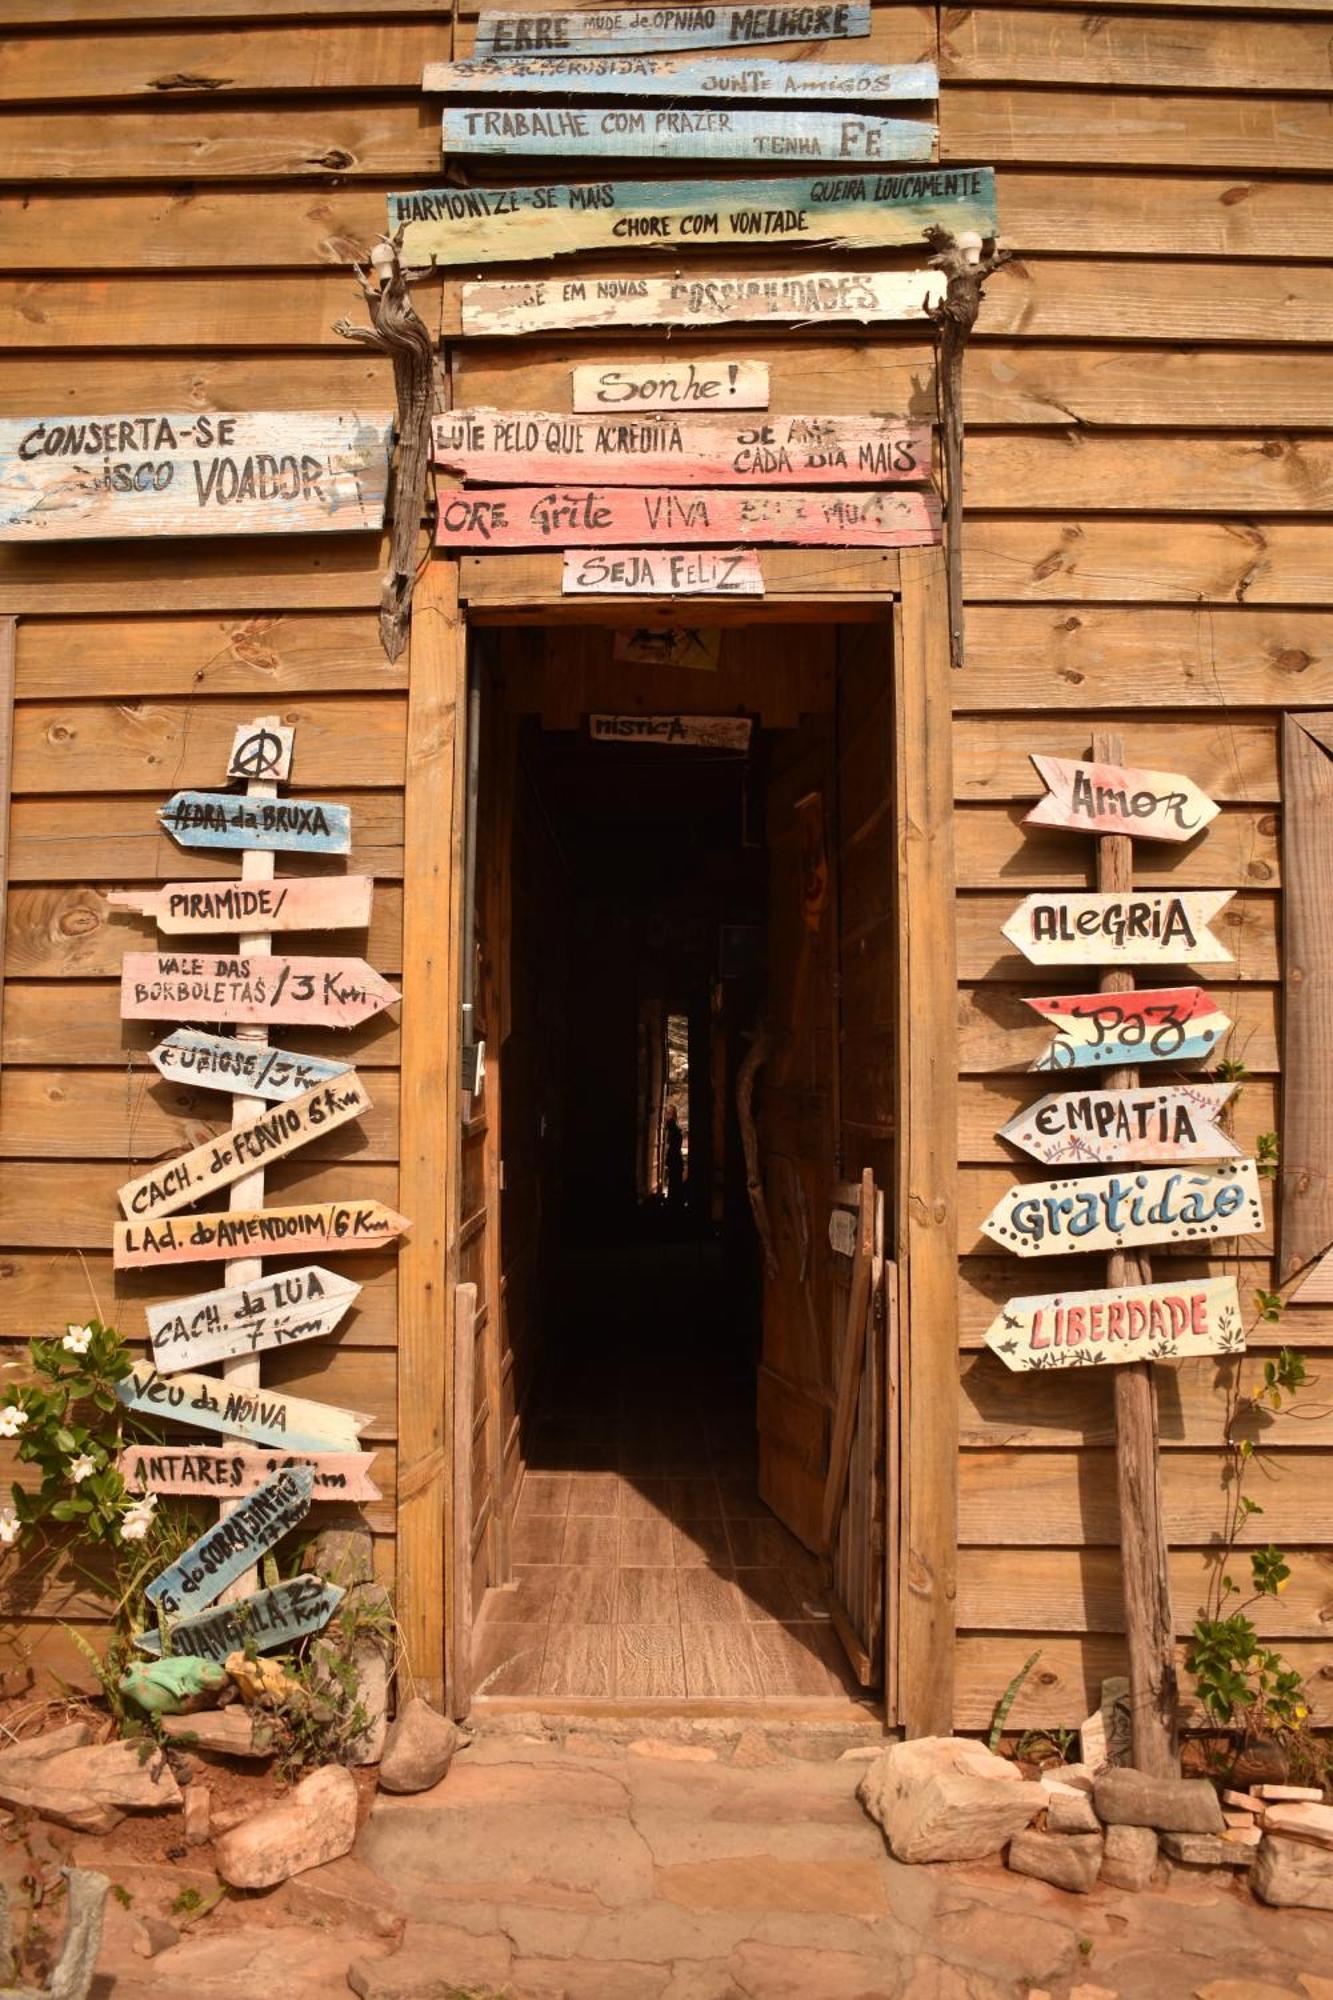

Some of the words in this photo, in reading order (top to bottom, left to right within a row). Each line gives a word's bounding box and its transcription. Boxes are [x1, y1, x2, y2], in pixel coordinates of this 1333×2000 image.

[493, 18, 570, 52] ERRE
[584, 14, 622, 30] MUDE
[630, 12, 649, 28] de
[728, 4, 849, 41] MELHORE
[464, 112, 590, 138] TRABALHE
[600, 113, 646, 134] COM
[655, 112, 733, 133] PRAZER
[753, 136, 821, 155] TENHA
[810, 180, 866, 202] QUEIRA
[875, 171, 983, 201] LOUCAMENTE
[397, 187, 558, 221] HARMONIZE-SE
[612, 215, 671, 237] CHORE
[680, 214, 718, 235] COM
[730, 209, 809, 235] VONTADE
[563, 283, 586, 302] EM
[597, 281, 649, 298] NOVAS
[597, 364, 738, 402] Sonhe!
[18, 416, 236, 460] CONSERTA-SE
[494, 422, 540, 452] PELO
[546, 423, 584, 454] QUE
[595, 422, 684, 454] ACREDITA
[733, 446, 793, 474] CADA
[859, 440, 921, 474] MAIS
[193, 454, 326, 507] VOADOR
[444, 500, 509, 539] ORE
[645, 495, 710, 529] VIVA
[577, 557, 655, 587] SEJA
[175, 800, 227, 833] PEDRA
[230, 805, 257, 829] da
[262, 805, 330, 837] BRUXA
[158, 958, 204, 977] VALE
[215, 960, 250, 979] DAS
[135, 978, 266, 1005] BORBOLETAS
[234, 1291, 267, 1319] da
[273, 1271, 325, 1308] LUA
[191, 1384, 220, 1413] da
[134, 1456, 246, 1488] ANTARES
